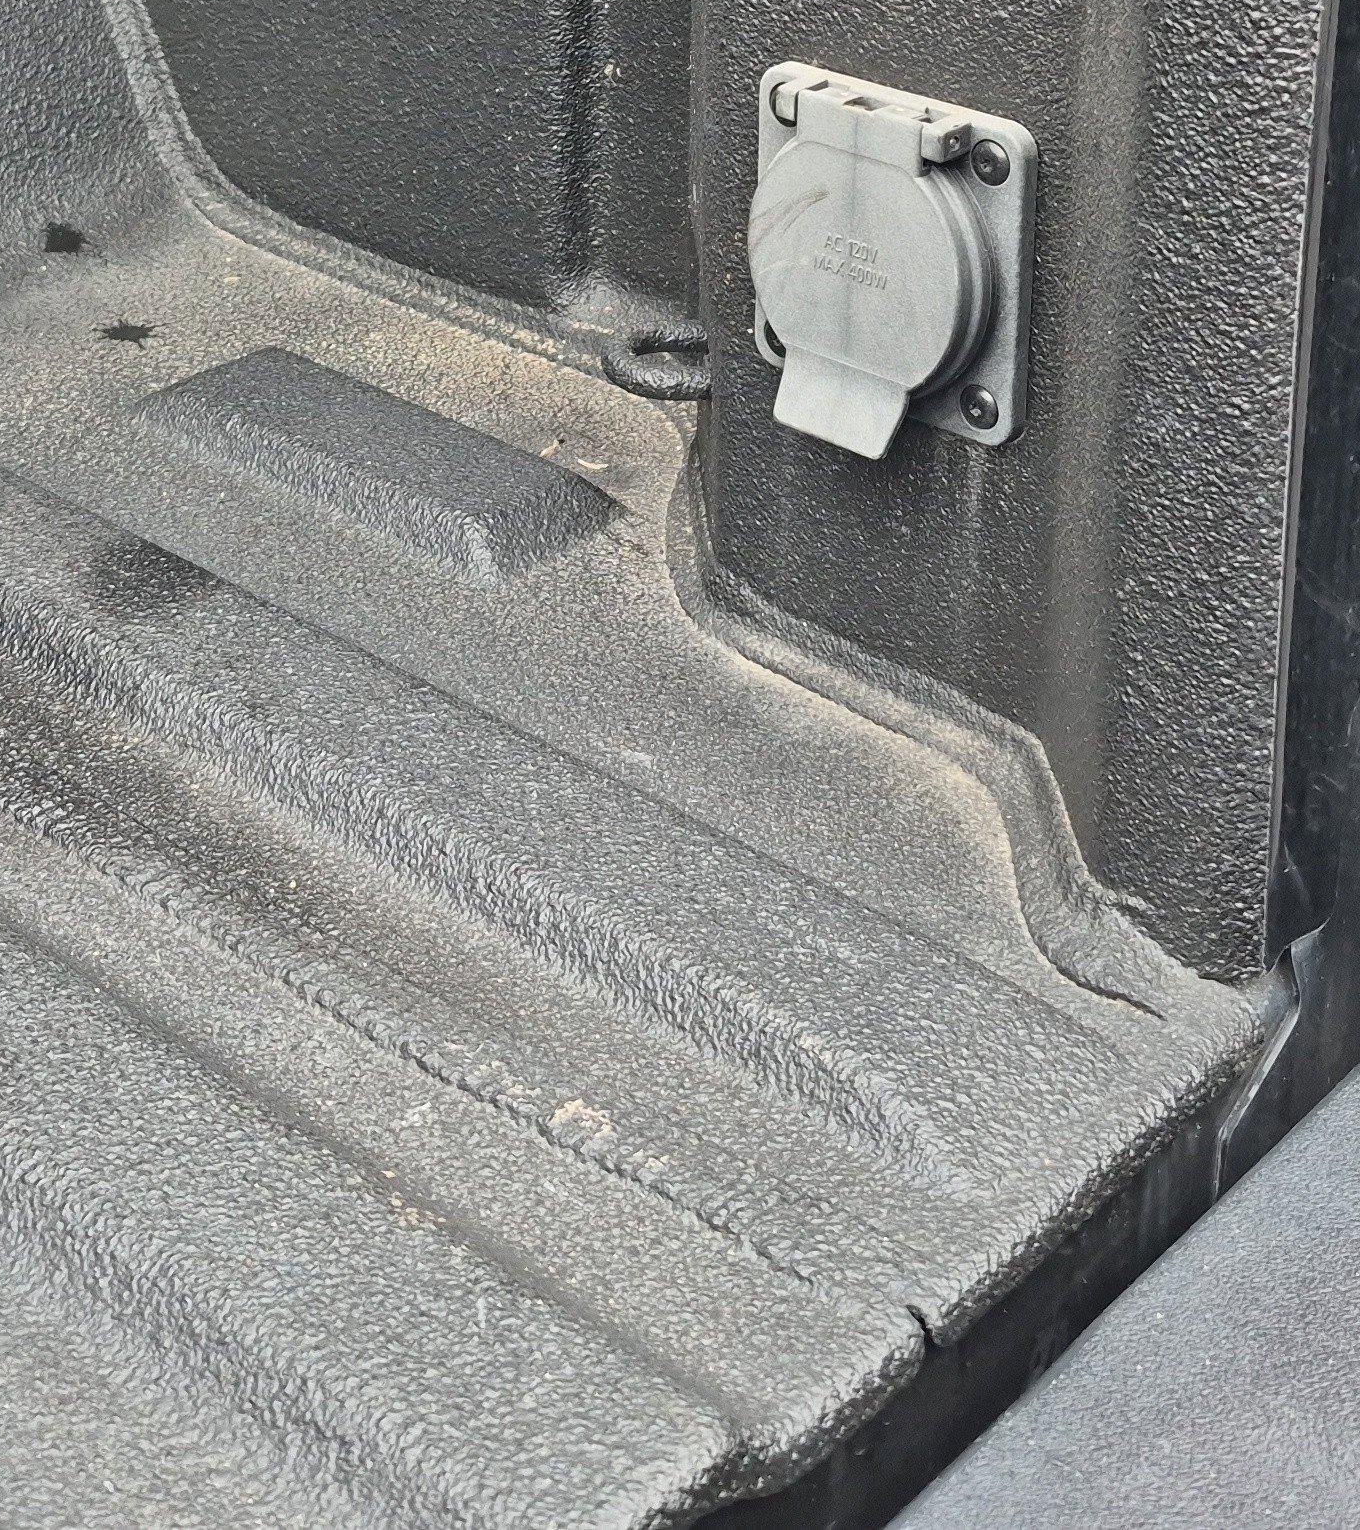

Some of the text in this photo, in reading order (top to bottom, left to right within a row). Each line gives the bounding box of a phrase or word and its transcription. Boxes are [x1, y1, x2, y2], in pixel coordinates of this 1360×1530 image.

[824, 233, 880, 265] AC 120V
[847, 264, 889, 291] 400W
